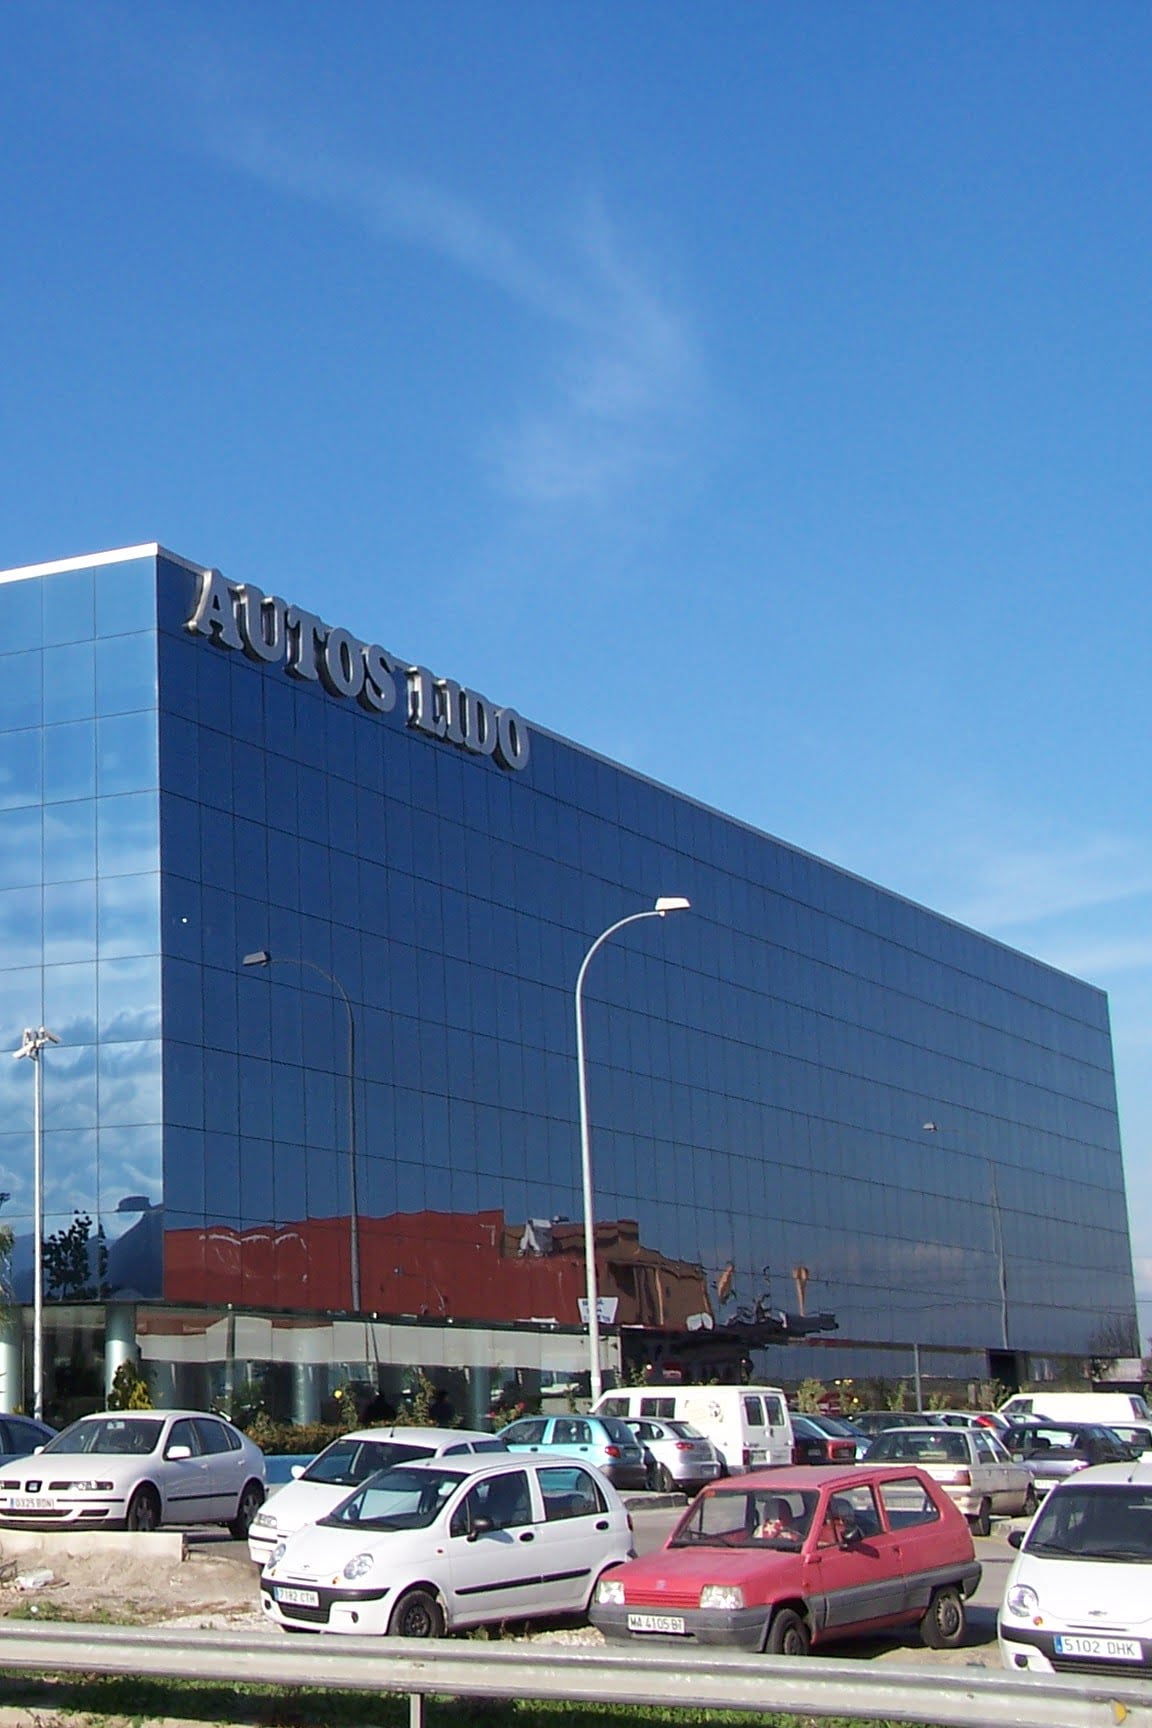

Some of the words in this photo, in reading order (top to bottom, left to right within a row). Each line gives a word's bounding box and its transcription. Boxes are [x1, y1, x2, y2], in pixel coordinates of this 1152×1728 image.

[183, 569, 397, 713] AUTOS
[405, 665, 529, 771] LIDO
[1064, 1638, 1100, 1654] 5102
[1107, 1641, 1136, 1657] DHK
